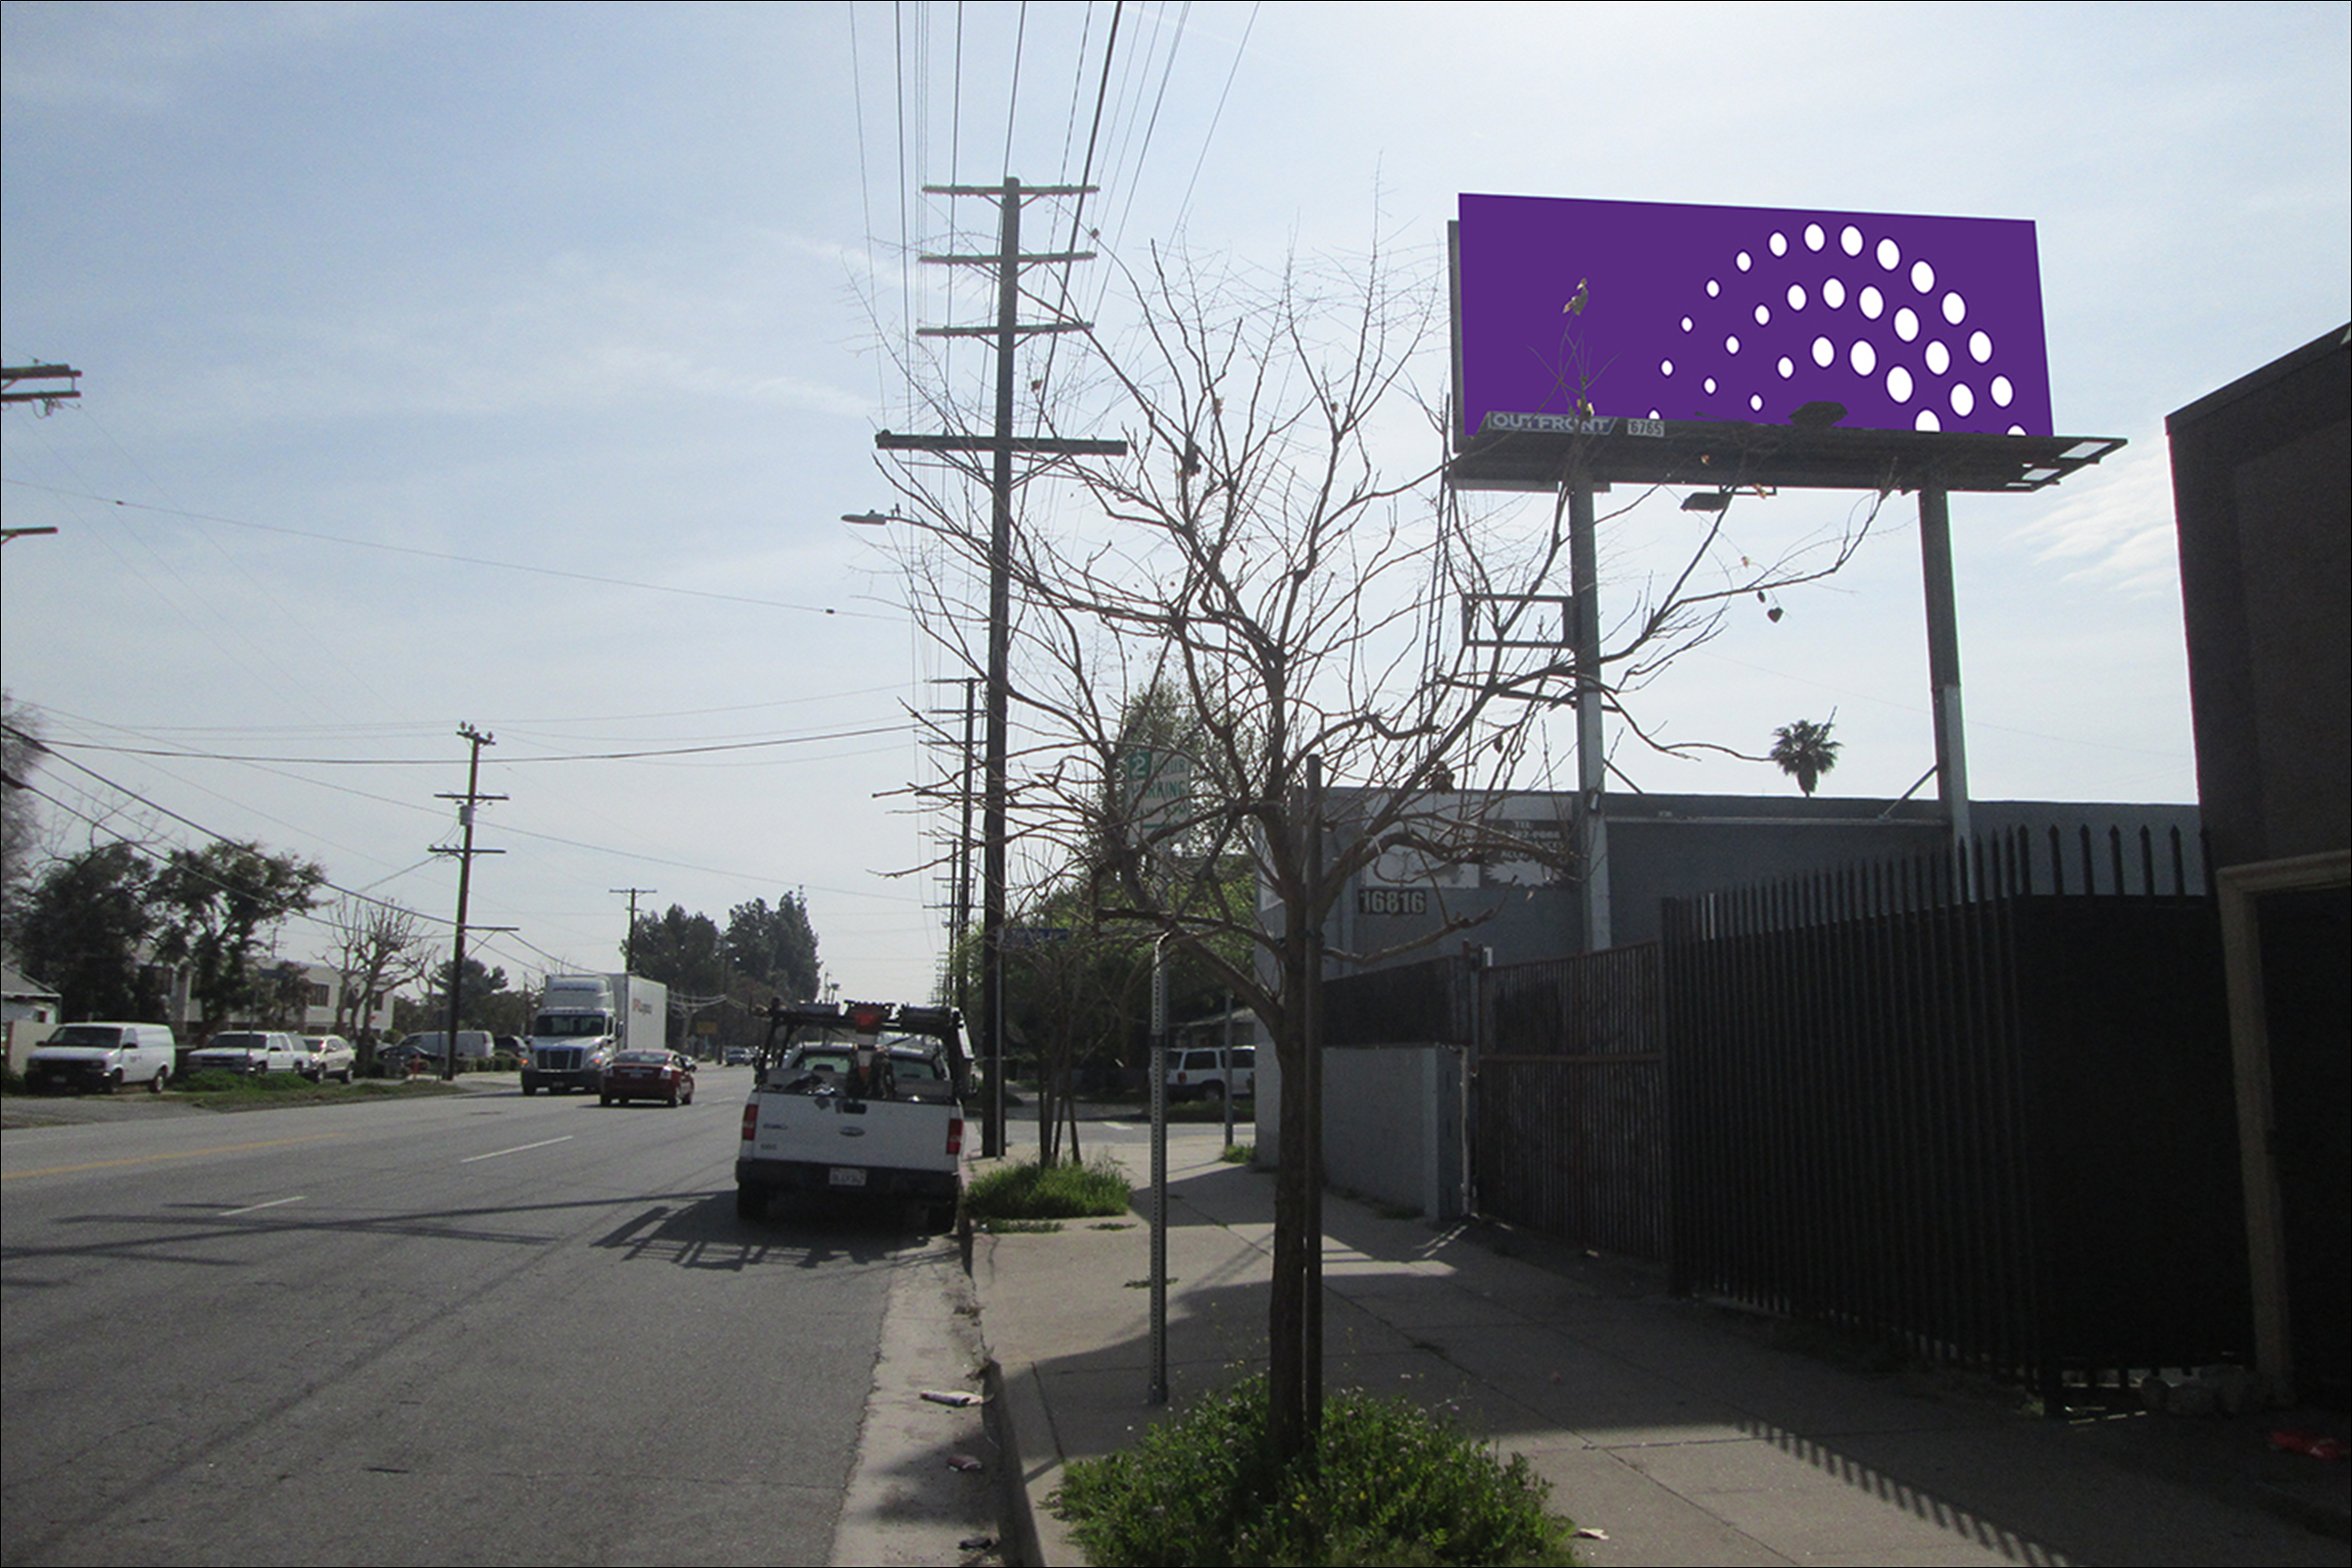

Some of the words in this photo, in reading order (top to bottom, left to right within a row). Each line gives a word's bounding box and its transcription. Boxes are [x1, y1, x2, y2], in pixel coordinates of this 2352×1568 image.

[1493, 413, 1610, 432] OUTFRONT
[1630, 419, 1664, 436] 6765
[1131, 755, 1147, 776] 2
[1132, 780, 1187, 799] PRKING
[1359, 890, 1425, 914] 16816
